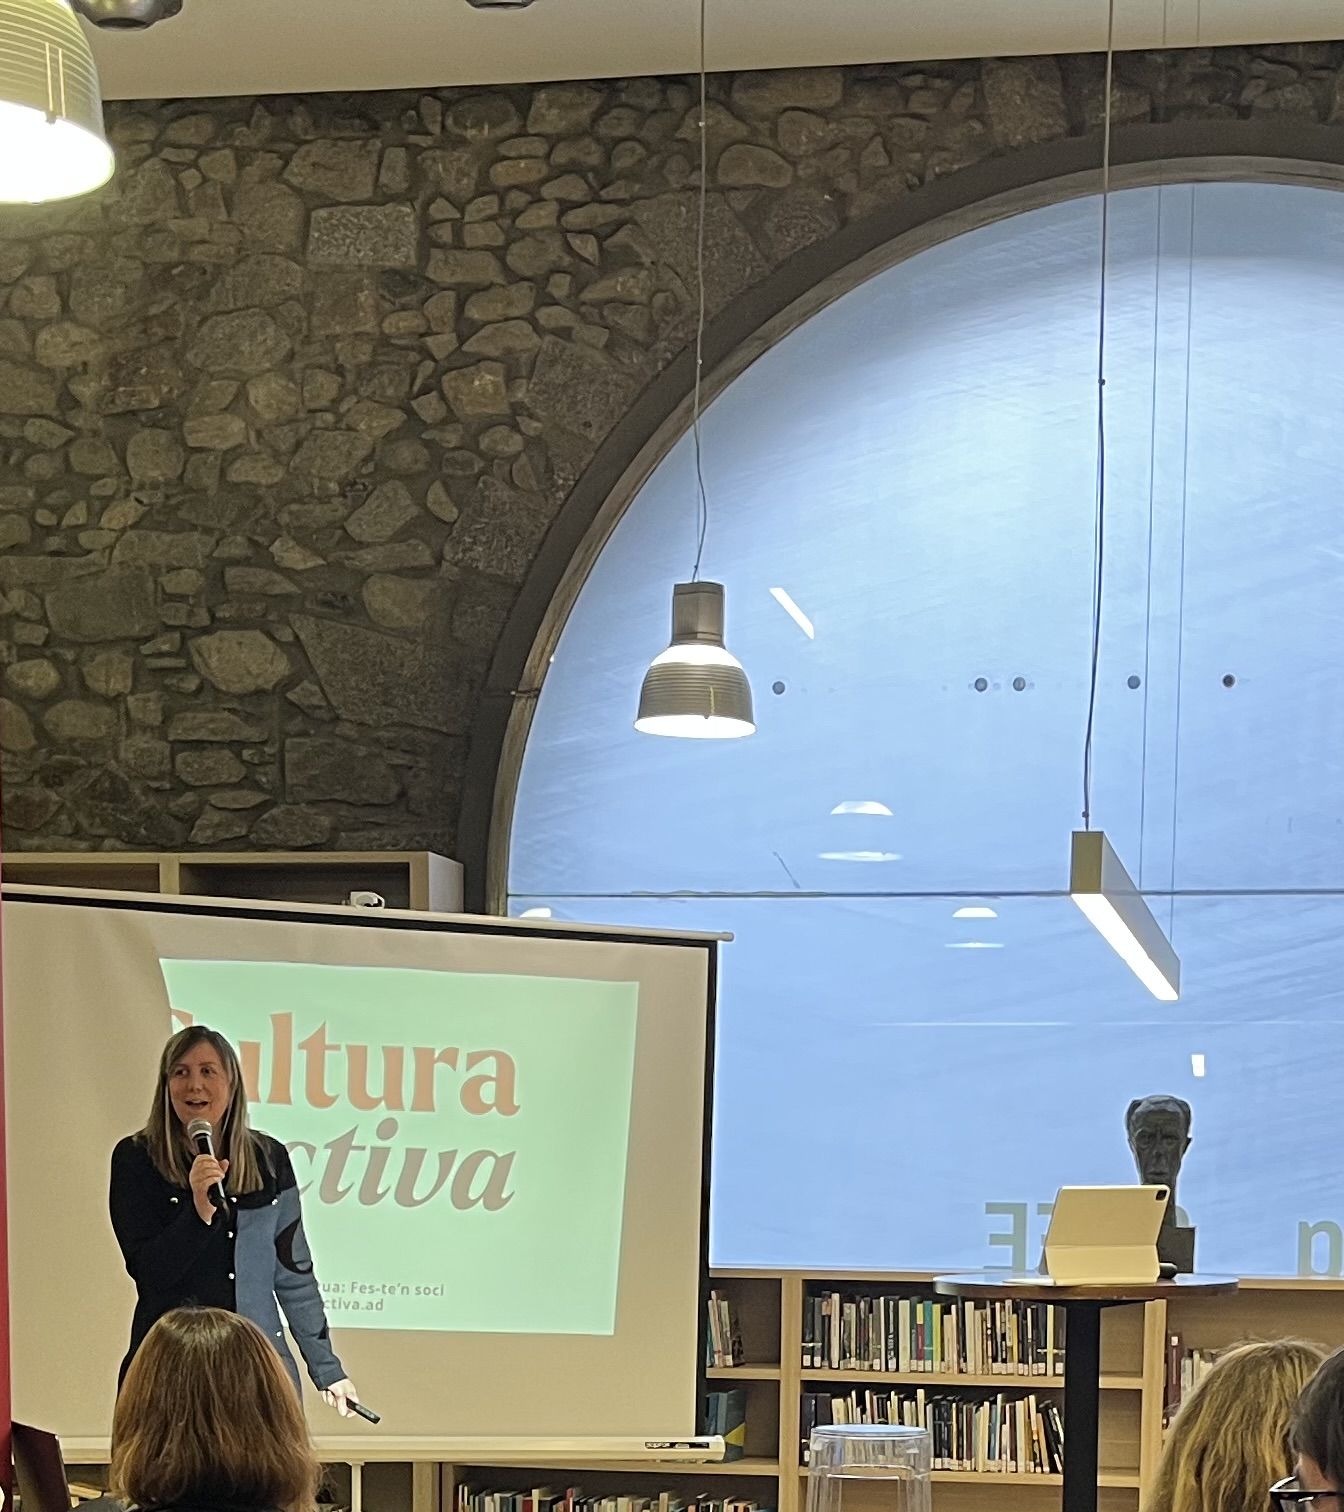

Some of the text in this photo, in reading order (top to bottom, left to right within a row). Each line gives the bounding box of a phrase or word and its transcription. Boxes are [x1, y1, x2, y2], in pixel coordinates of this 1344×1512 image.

[320, 1282, 346, 1294] ua:
[414, 1284, 444, 1297] soci
[322, 1297, 385, 1312] ctiva.ad
